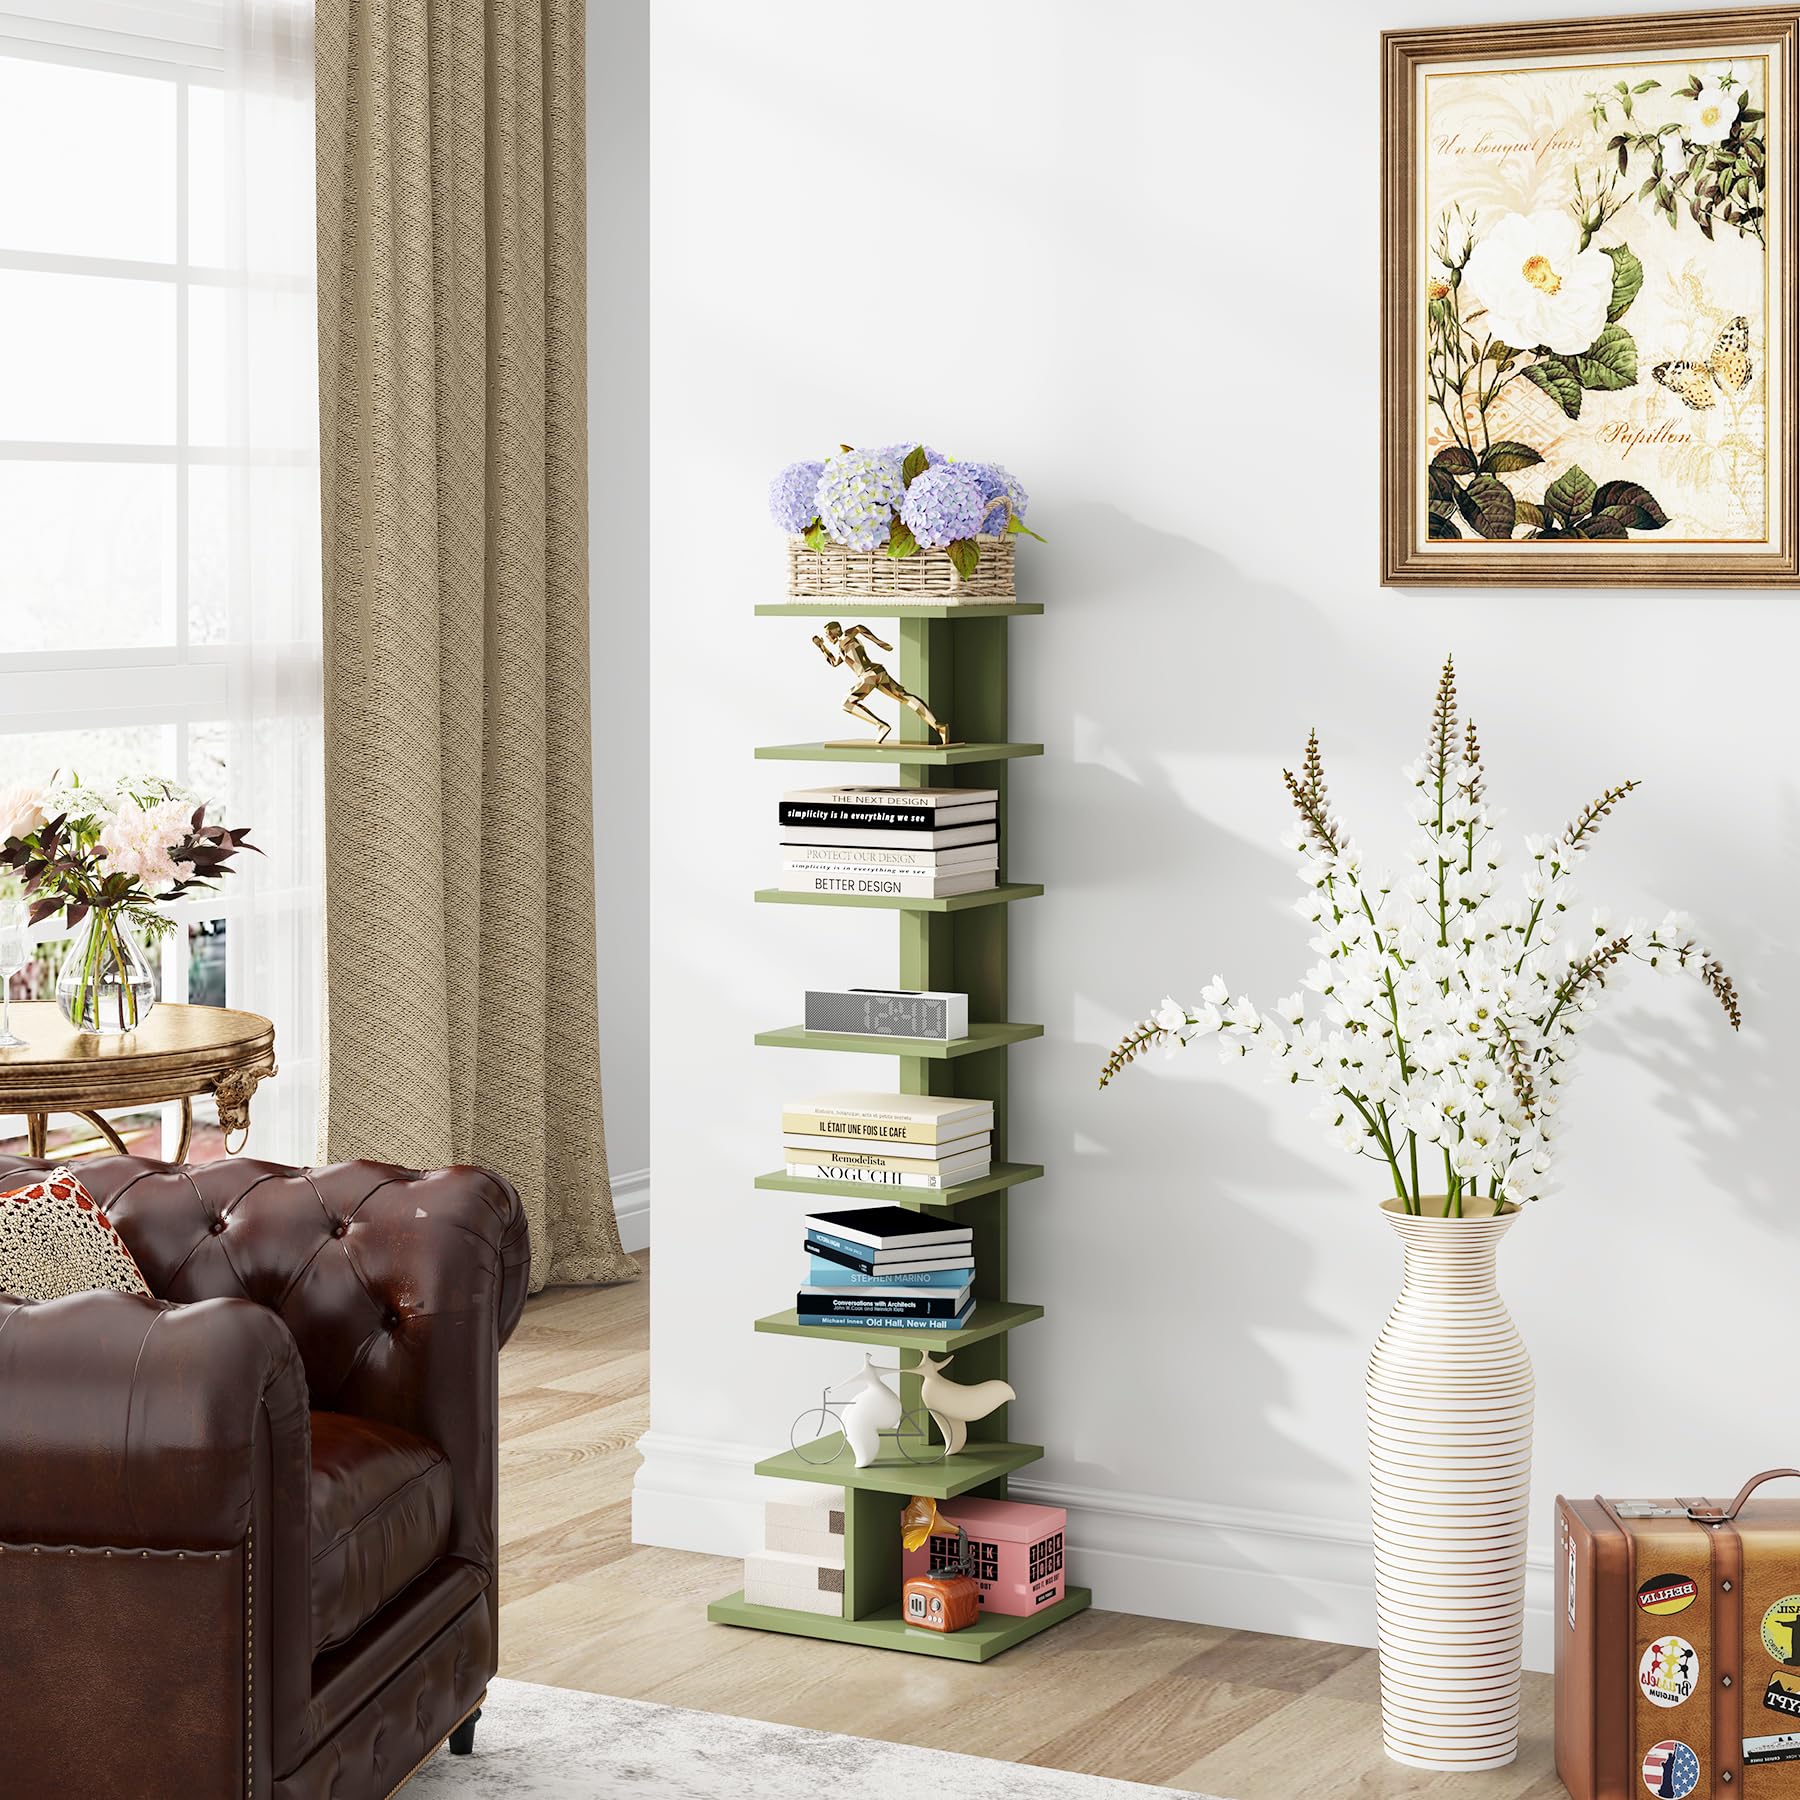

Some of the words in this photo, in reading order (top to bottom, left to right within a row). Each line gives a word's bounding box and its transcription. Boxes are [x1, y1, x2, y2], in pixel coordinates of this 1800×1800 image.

[1433, 133, 1468, 155] Un
[1473, 131, 1540, 167] bouquet
[1595, 417, 1691, 460] Papillon
[832, 795, 852, 803] THE
[855, 796, 883, 804] NEXT
[887, 797, 929, 806] DESIGN
[787, 809, 828, 820] simplicity
[830, 810, 838, 819] is
[840, 811, 848, 820] in
[851, 812, 895, 823] everything
[897, 814, 909, 822] we
[911, 815, 925, 823] see
[807, 849, 851, 860] PROTECT
[854, 852, 876, 862] OUR
[879, 853, 916, 863] DESIGN
[815, 878, 855, 891] BETTER
[858, 879, 901, 893] DESIGN
[863, 997, 942, 1036] 12:40
[819, 1122, 826, 1132] IL
[827, 1120, 846, 1133] ÉTAIT
[847, 1123, 861, 1135] UNE
[863, 1125, 878, 1136] FOIS
[879, 1126, 887, 1137] LE
[889, 1126, 907, 1138] CAFÉ
[831, 1153, 886, 1167] Remodelista
[817, 1166, 902, 1185] NOGUCHI
[851, 1274, 892, 1283] STEPHEN
[894, 1274, 931, 1283] MARINO
[887, 1301, 916, 1309] Architects
[866, 1318, 882, 1327] Old
[885, 1319, 904, 1328] Hall,
[907, 1320, 927, 1328] New
[929, 1320, 947, 1329] Hall
[936, 1540, 993, 1559] TICK
[1032, 1536, 1061, 1561] TICK
[935, 1558, 993, 1578] TOK
[1032, 1554, 1061, 1580] TOCK
